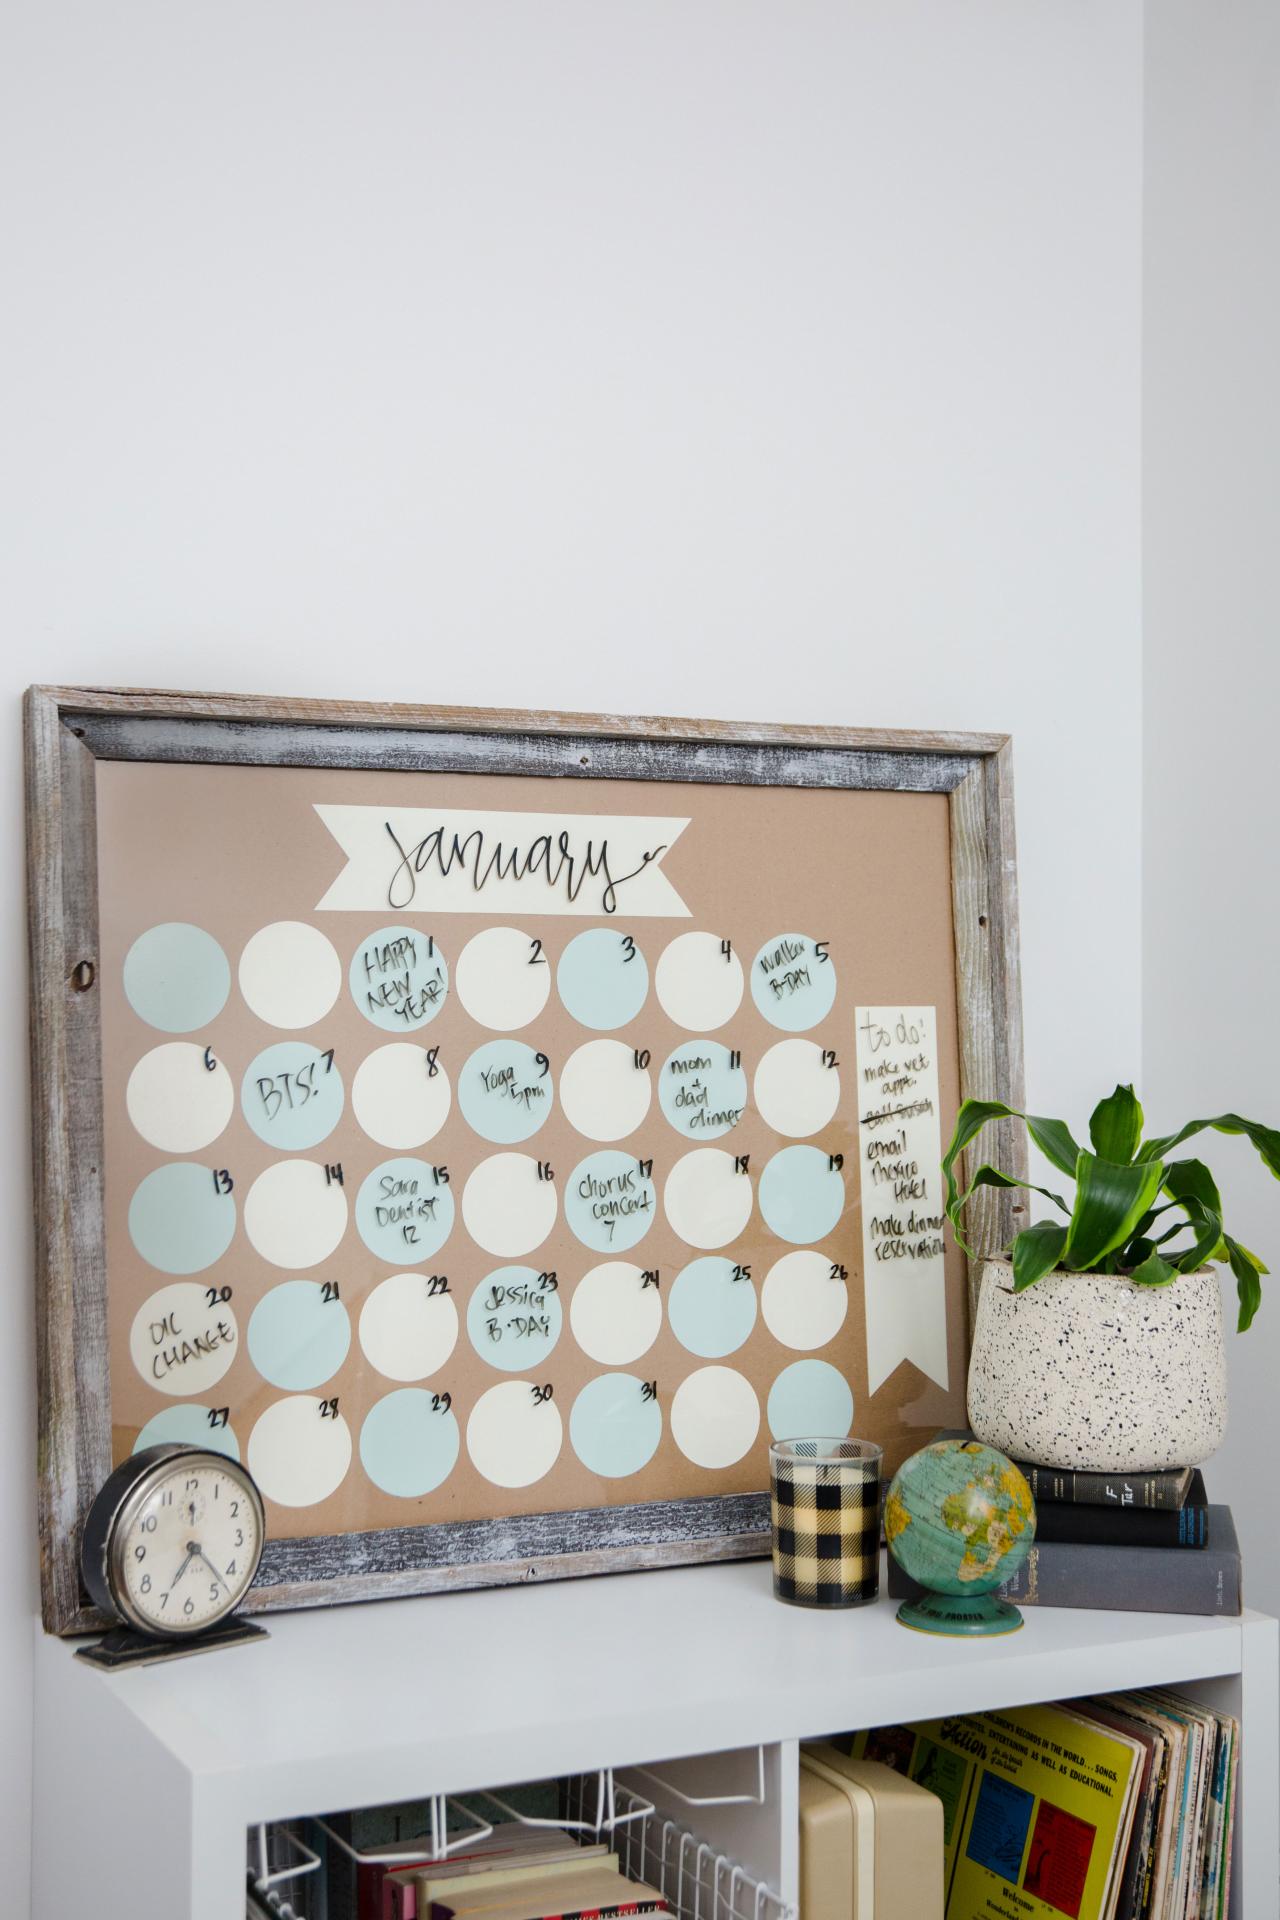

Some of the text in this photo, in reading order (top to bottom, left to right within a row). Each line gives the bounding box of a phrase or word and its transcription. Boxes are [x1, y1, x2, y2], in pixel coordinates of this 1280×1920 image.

[364, 936, 417, 984] HAPPY
[528, 939, 546, 965] 2
[621, 936, 636, 963] 3
[721, 939, 732, 963] 4
[815, 942, 830, 963] 5
[367, 971, 410, 1013] NEW
[860, 1008, 891, 1053] to
[204, 1046, 217, 1072] 6
[321, 1049, 335, 1074] 7
[427, 1046, 440, 1077] 8
[535, 1052, 550, 1078] 9
[634, 1050, 650, 1070] 10
[671, 1057, 712, 1074] mom
[730, 1050, 741, 1070] 11
[821, 1050, 840, 1068] 12
[480, 1064, 514, 1097] Yoga
[864, 1059, 899, 1082] make
[257, 1062, 319, 1121] BTS!
[510, 1082, 546, 1111] 5pm
[675, 1086, 709, 1108] dad
[867, 1129, 907, 1160] email
[537, 1161, 555, 1181] 16
[639, 1159, 653, 1179] 17
[735, 1155, 750, 1176] 18
[829, 1153, 844, 1172] 19
[213, 1169, 234, 1195] 13
[324, 1163, 344, 1186] 14
[432, 1166, 450, 1186] 15
[380, 1176, 419, 1200] Sara
[592, 1190, 653, 1220] concert
[403, 1225, 421, 1244] 12
[603, 1220, 616, 1241] 7
[537, 1271, 559, 1293] 23
[640, 1270, 660, 1290] 24
[732, 1265, 751, 1282] 25
[829, 1264, 848, 1282] 26
[205, 1285, 233, 1308] 20
[320, 1281, 340, 1304] 21
[427, 1276, 452, 1298] 22
[149, 1312, 182, 1345] OIL
[152, 1322, 235, 1379] CHANGE
[432, 1392, 452, 1414] 29
[531, 1383, 554, 1406] 30
[640, 1381, 658, 1403] 31
[208, 1407, 230, 1429] 27
[319, 1397, 340, 1420] 28
[185, 1479, 199, 1491] 12
[1106, 1485, 1117, 1499] F
[1121, 1483, 1133, 1506] Tur
[230, 1502, 240, 1518] 2
[141, 1515, 157, 1533] 10
[234, 1529, 243, 1547] 3
[135, 1545, 146, 1563] 9
[226, 1560, 236, 1576] 4
[140, 1575, 152, 1594] 8
[210, 1583, 219, 1601] 5
[160, 1593, 169, 1610] 7
[184, 1597, 194, 1615] 6
[989, 1729, 1028, 1756] ENTERTAINING
[1031, 1750, 1039, 1761] AS
[1041, 1755, 1056, 1770] WELL
[1059, 1763, 1067, 1775] AS
[1070, 1771, 1114, 1798] EDUCATIONAL.
[1016, 1726, 1041, 1746] RECORDS
[1050, 1742, 1062, 1756] THE
[1095, 1764, 1118, 1782] SONGS,
[1002, 1887, 1035, 1912] Welcome
